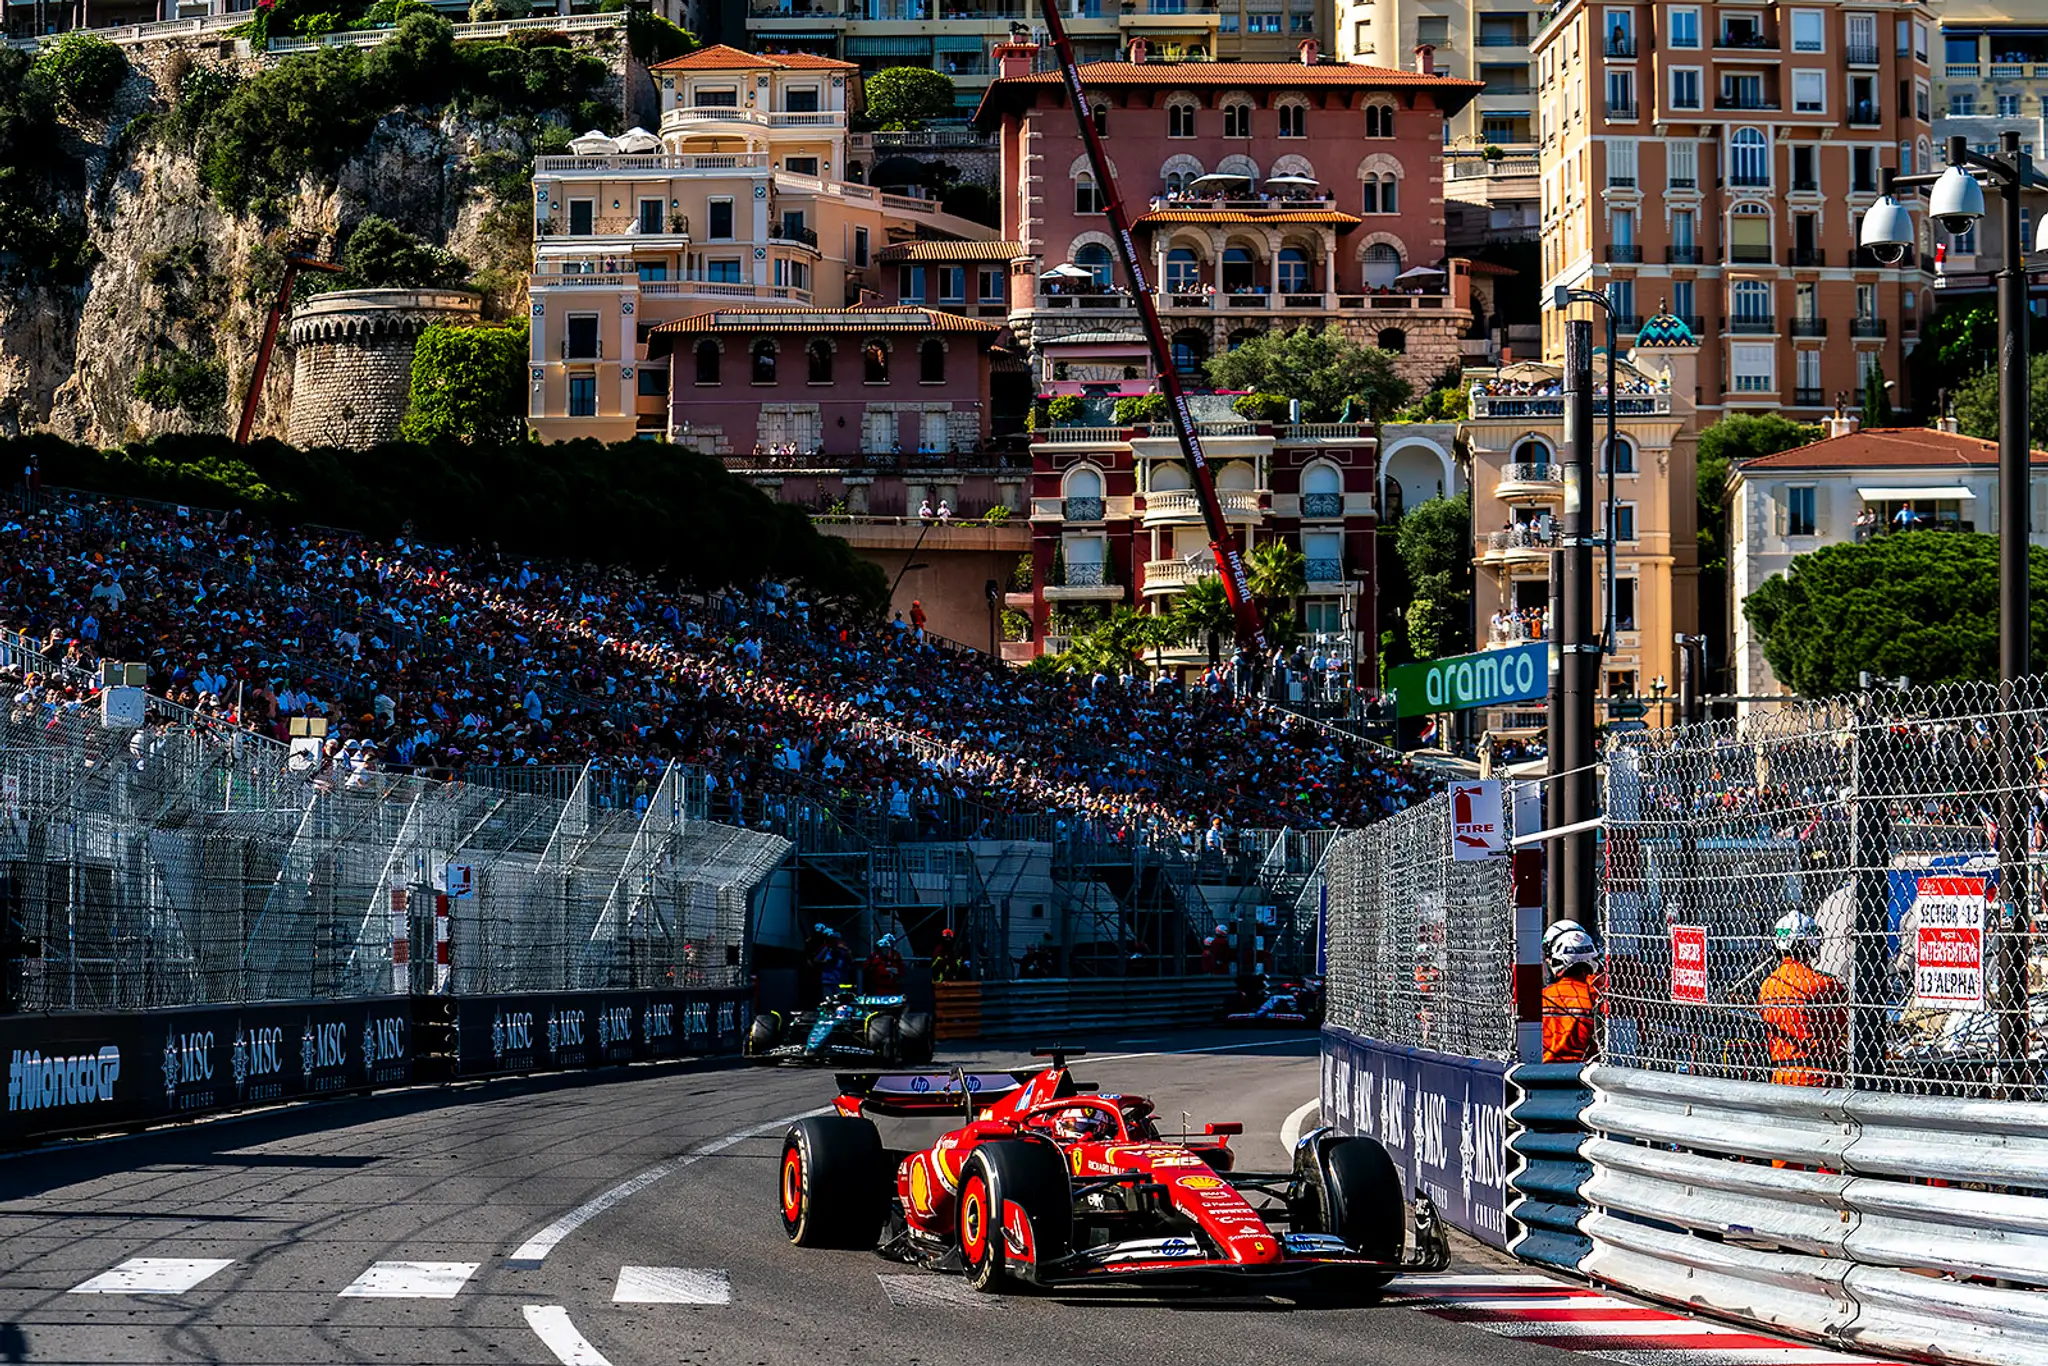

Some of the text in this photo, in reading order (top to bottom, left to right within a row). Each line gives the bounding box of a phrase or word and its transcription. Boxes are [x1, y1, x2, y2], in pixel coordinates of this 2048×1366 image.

[1175, 395, 1205, 469] IMPERIAL LEVAGE
[1227, 550, 1252, 603] IMPERIAL
[1426, 652, 1534, 706] aramco
[1456, 823, 1494, 834] FIRE
[1920, 903, 1959, 924] SECTEUR
[1920, 970, 1977, 995] 13 ALPHA
[376, 1017, 404, 1060] MSC
[506, 1012, 533, 1050] MSC
[560, 1009, 584, 1046] MSC
[610, 1006, 632, 1041] MSC
[653, 1003, 674, 1037] MSC
[181, 1030, 214, 1083] MSC
[250, 1027, 282, 1075] MSC
[317, 1022, 346, 1067] MSC
[913, 1076, 928, 1092] hp
[1388, 1078, 1406, 1150] MSC
[1423, 1092, 1447, 1170] MSC
[1151, 1156, 1203, 1168] 16
[1475, 1103, 1504, 1189] MSC
